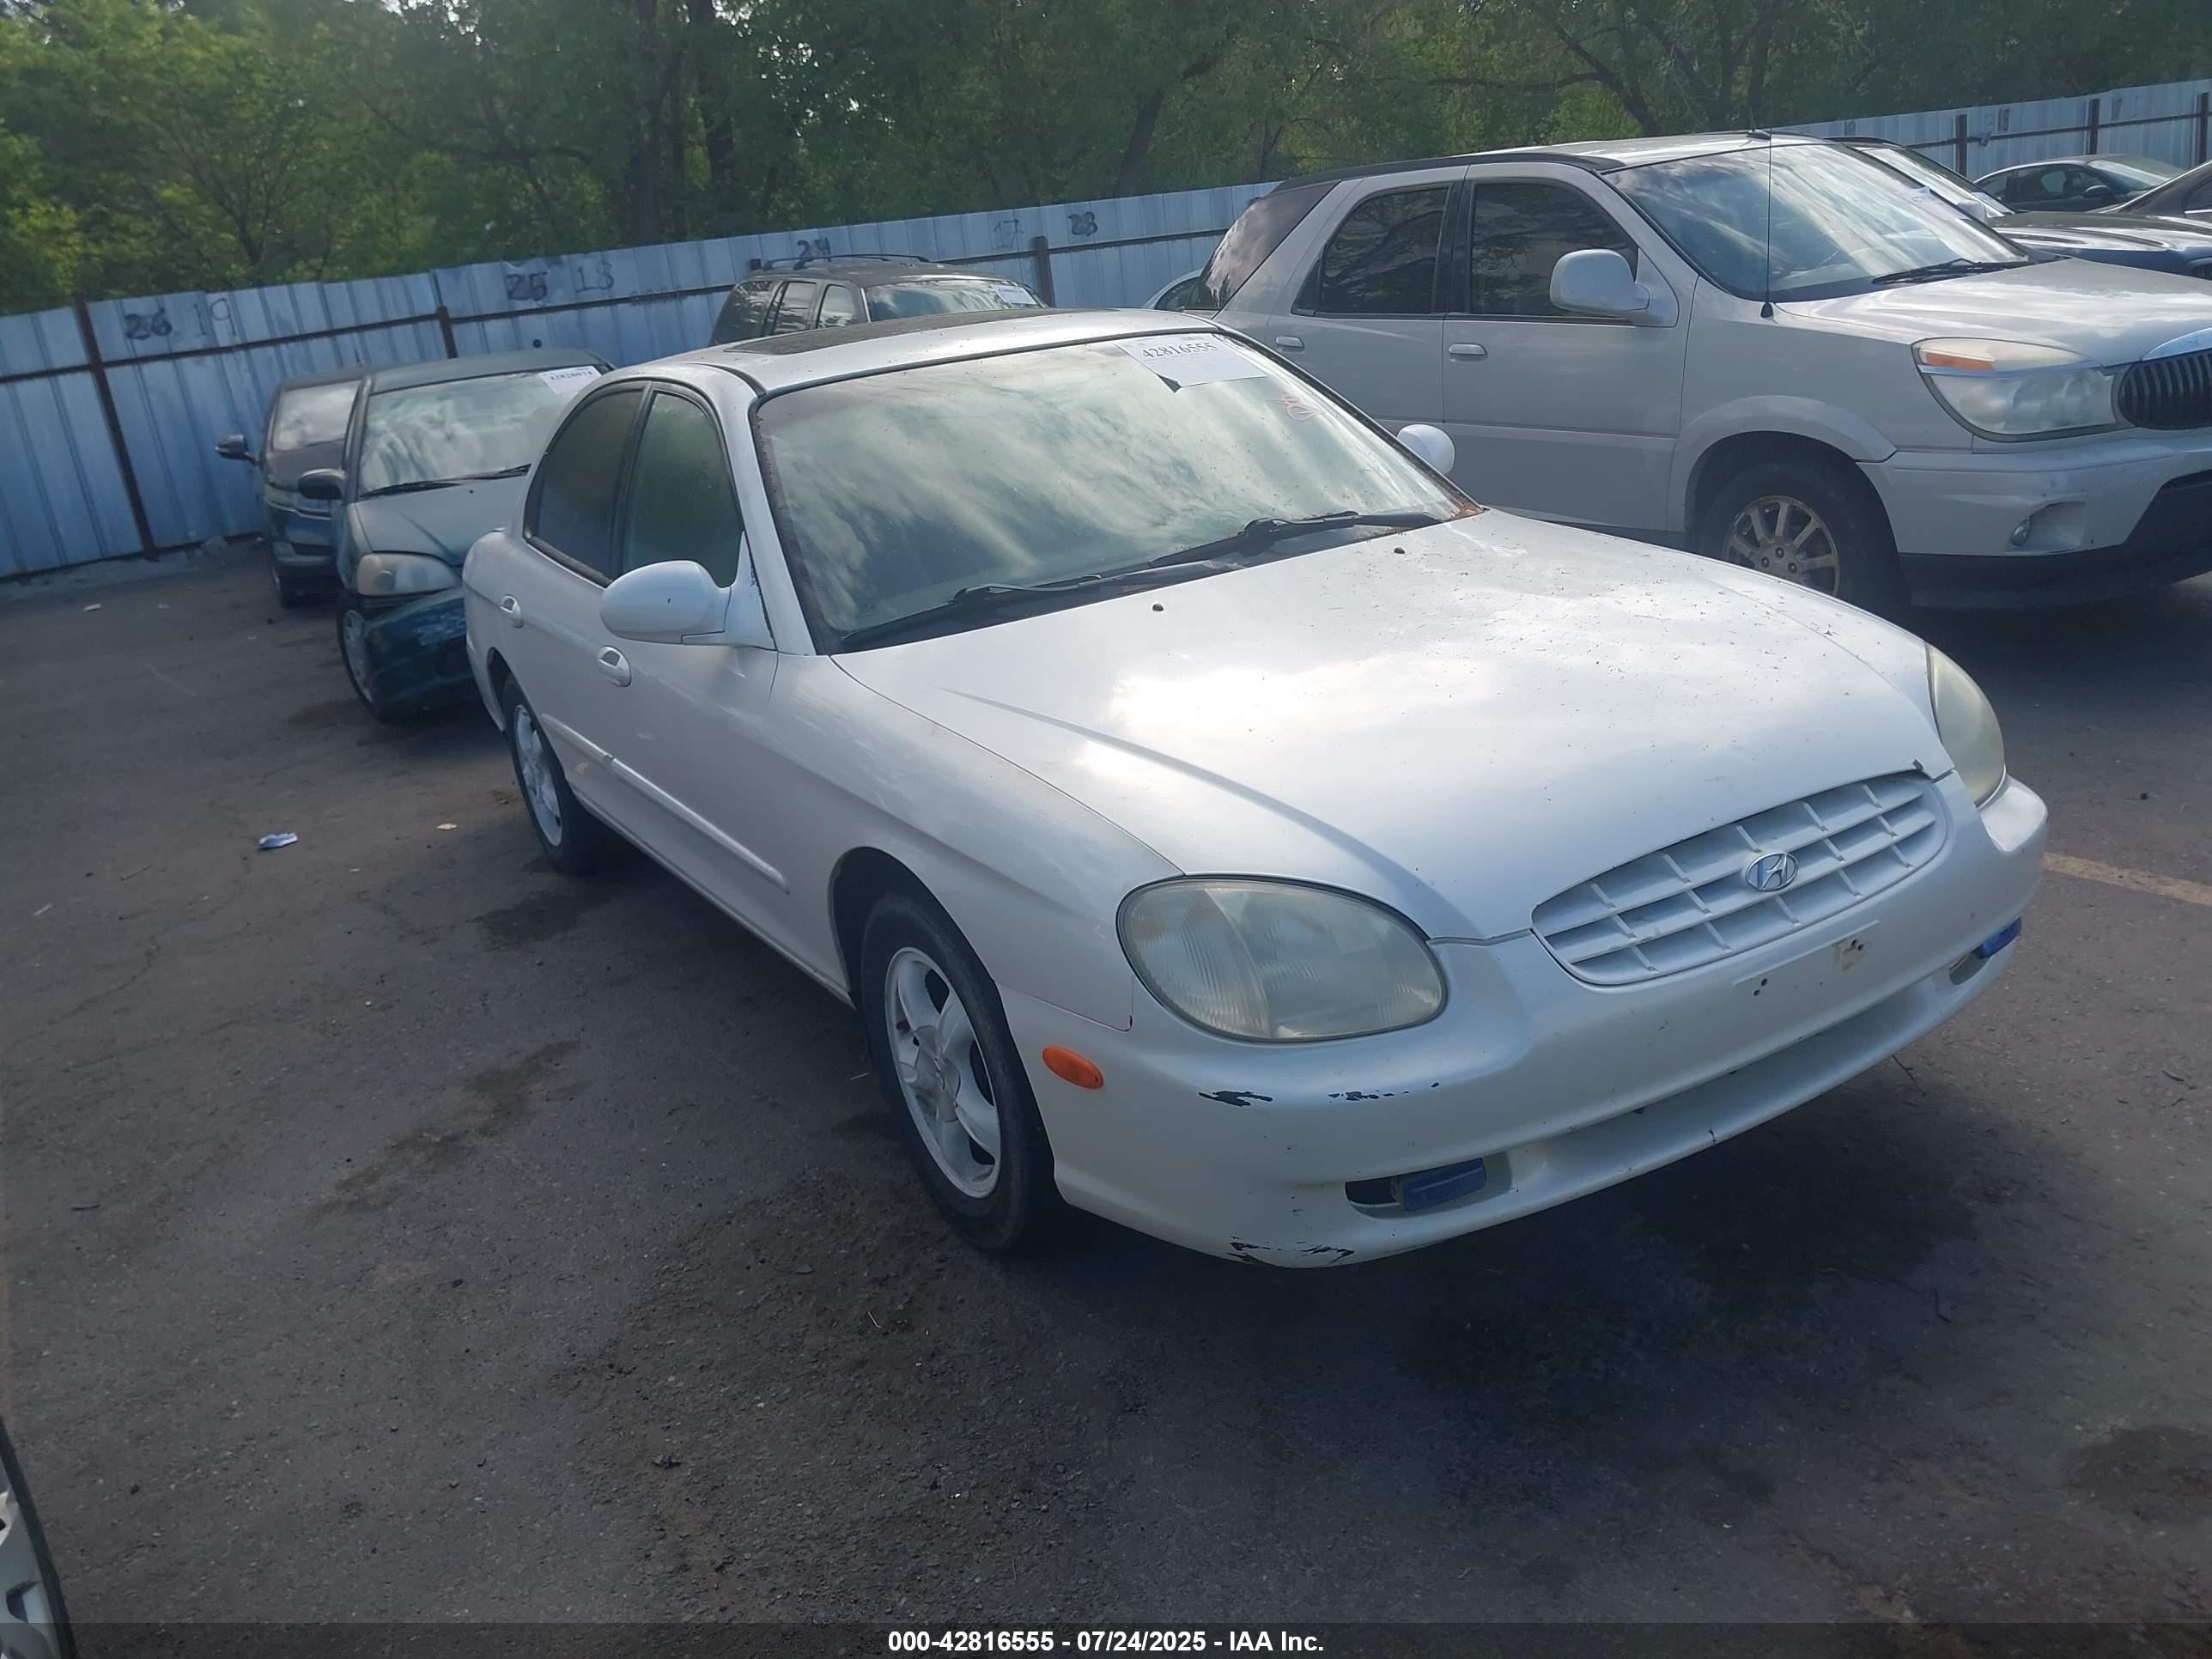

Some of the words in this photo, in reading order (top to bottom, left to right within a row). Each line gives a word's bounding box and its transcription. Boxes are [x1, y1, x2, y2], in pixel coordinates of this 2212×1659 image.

[506, 271, 548, 301] 25
[124, 307, 173, 340] 26
[1141, 342, 1218, 359] 42816555
